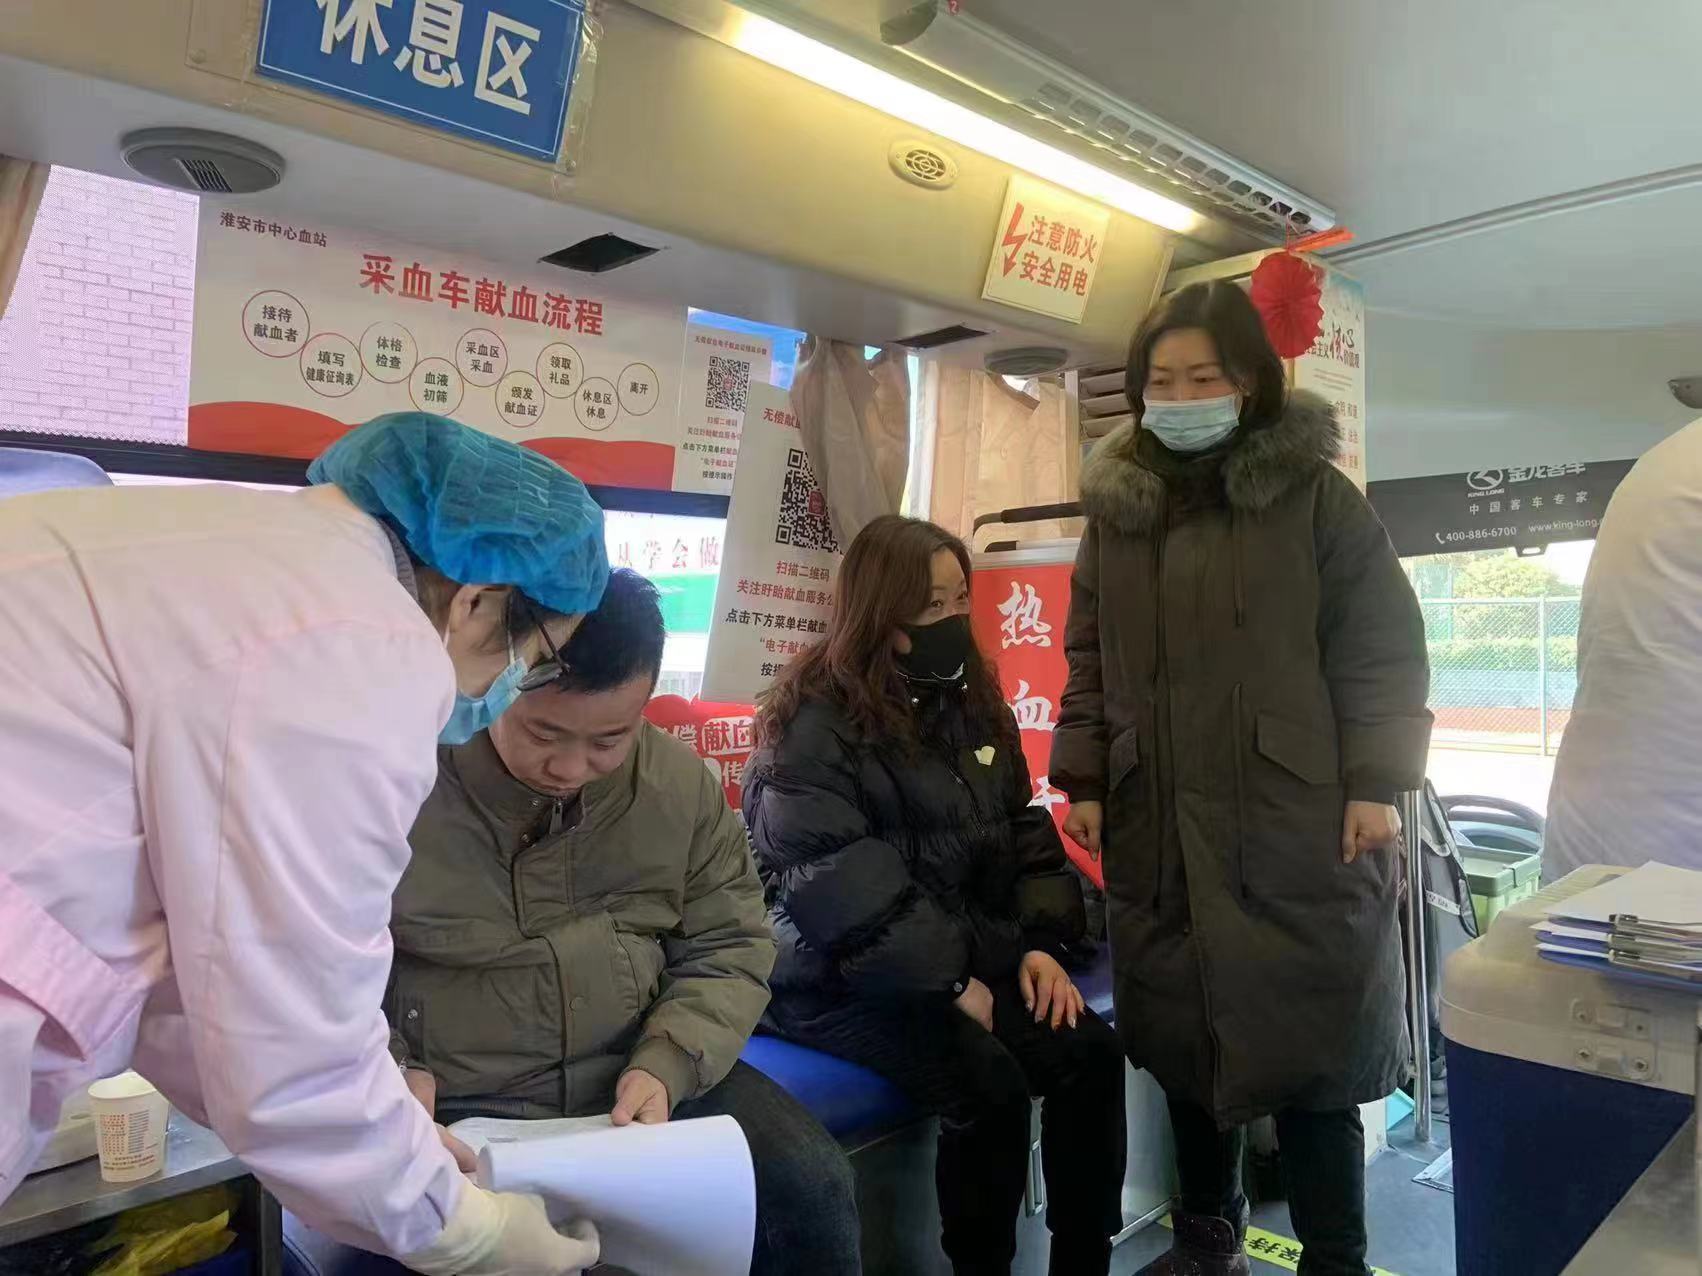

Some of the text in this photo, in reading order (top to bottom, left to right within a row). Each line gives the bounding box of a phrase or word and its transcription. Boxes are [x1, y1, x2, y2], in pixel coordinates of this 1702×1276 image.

[315, 0, 541, 116] 休息区
[220, 211, 328, 248] 淮安市中心血站
[1027, 215, 1098, 264] 注意防火
[1019, 251, 1088, 297] 安全用电
[359, 254, 603, 336] 采血车献血流程
[262, 304, 293, 324] 接待
[253, 323, 299, 343] 献血者
[376, 336, 403, 352] 体格
[466, 341, 500, 359] 采血区
[317, 350, 346, 367] 填写
[375, 353, 402, 370] 检查
[470, 359, 494, 374] 采血
[550, 356, 572, 370] 领取
[424, 371, 449, 388] 血液
[549, 372, 571, 386] 礼品
[423, 388, 448, 404] 初筛
[511, 386, 534, 401] 颁发
[629, 381, 649, 395] 离开
[582, 389, 613, 405] 休息区
[504, 401, 538, 417] 献血证
[586, 405, 607, 419] 休息
[1507, 463, 1586, 483] 金龙客车
[1486, 488, 1505, 496] LONG
[1445, 526, 1517, 542] 400-886-6700
[776, 560, 830, 583] 扫描二维码
[1243, 1237, 1301, 1264] 保持
